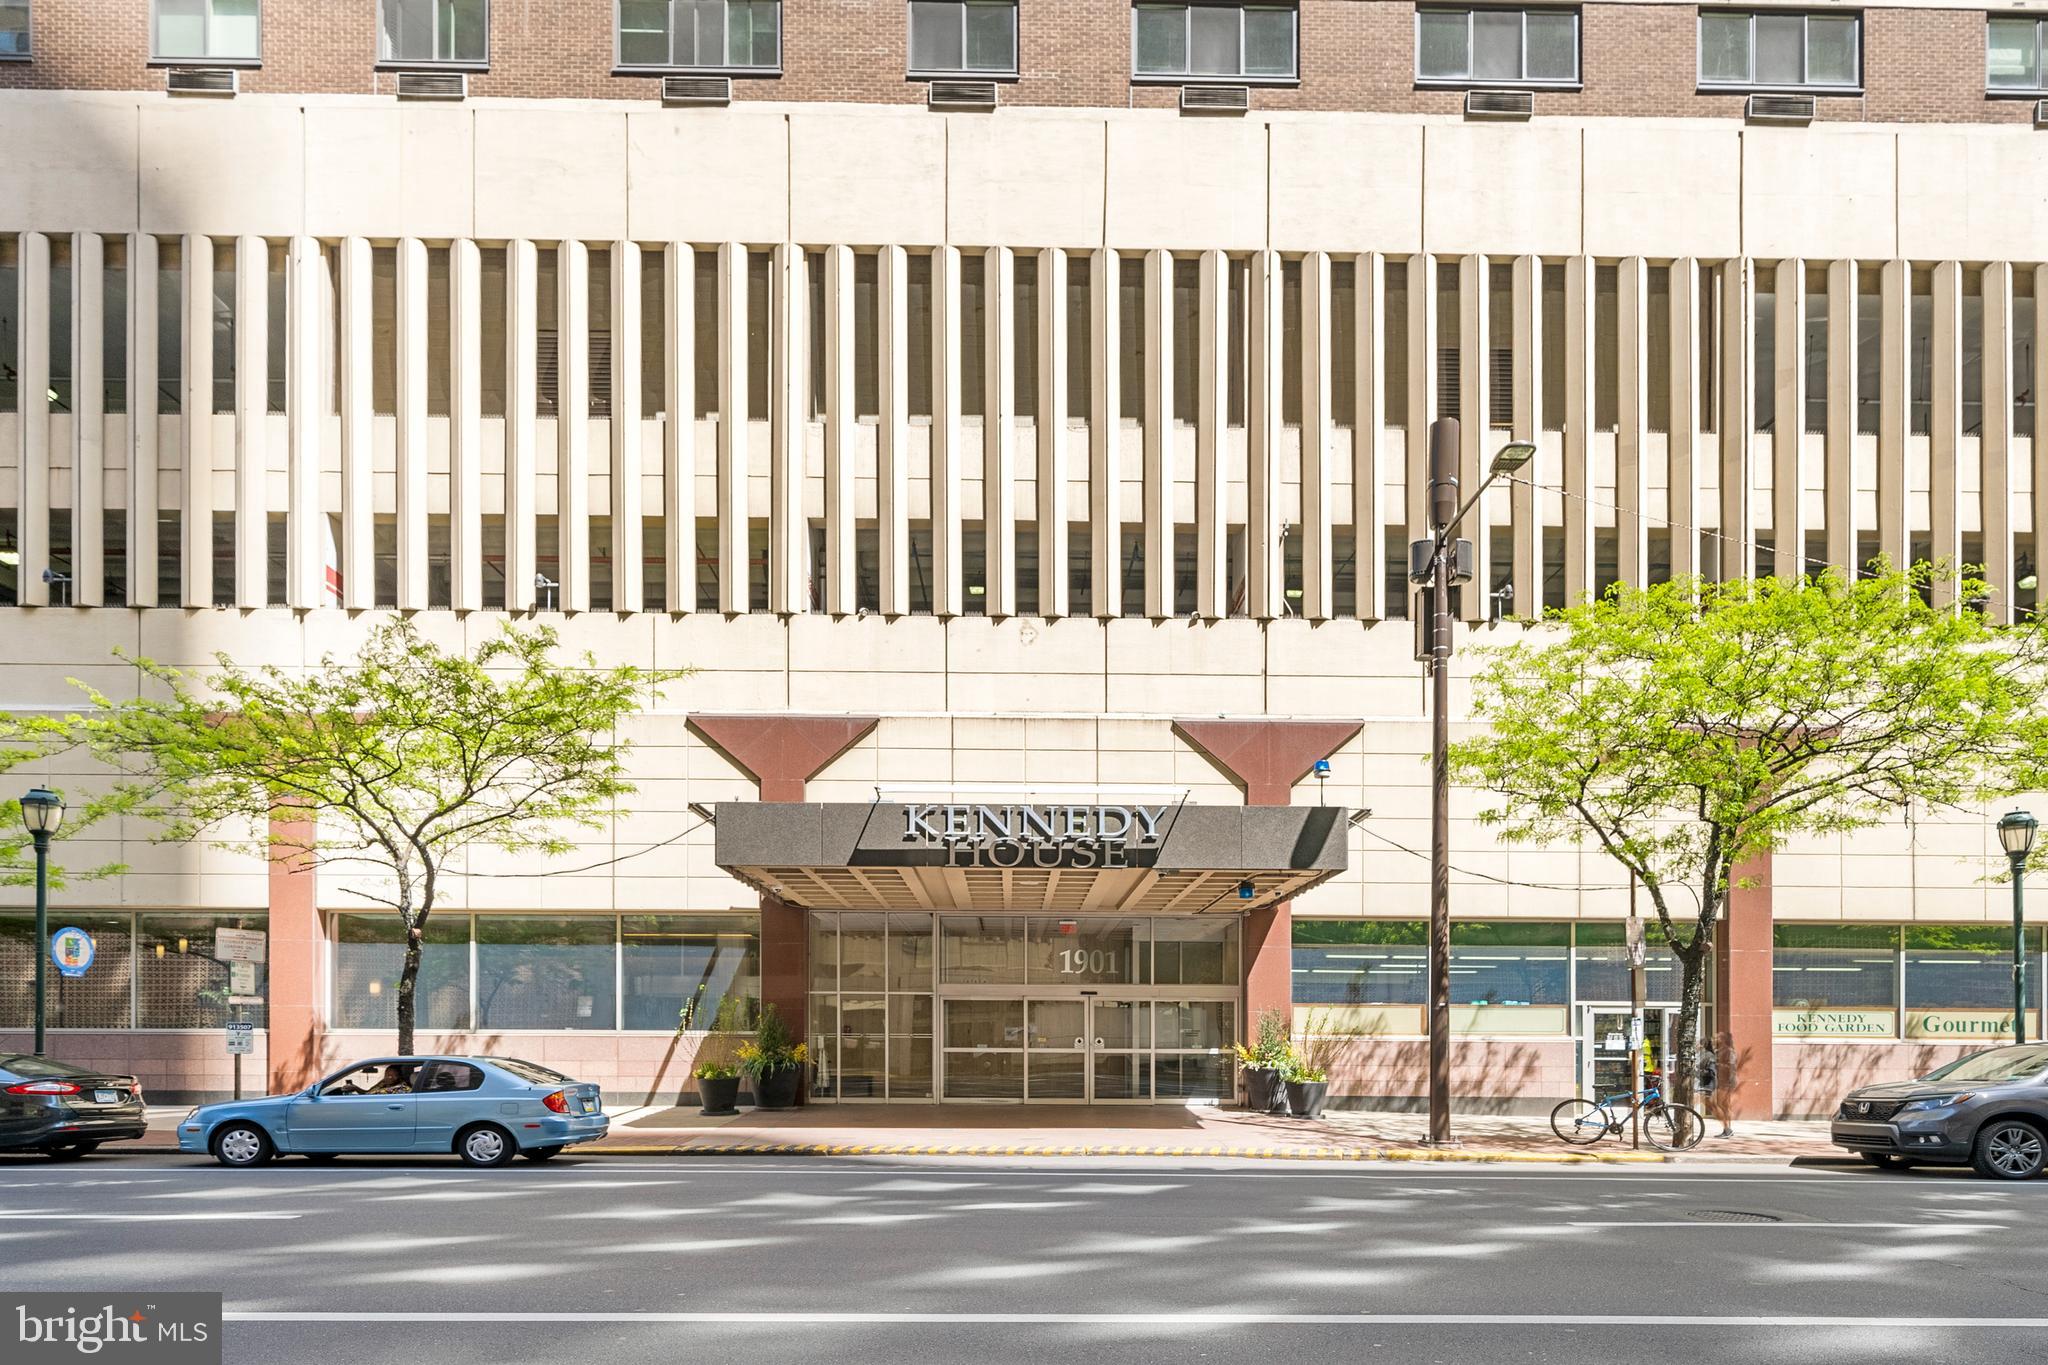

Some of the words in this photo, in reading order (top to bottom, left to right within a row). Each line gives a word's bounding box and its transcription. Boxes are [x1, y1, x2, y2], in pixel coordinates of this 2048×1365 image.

[904, 804, 1167, 837] KENNEDY
[945, 836, 1129, 868] HOUSE
[1059, 949, 1119, 974] 1901
[1778, 1023, 1818, 1032] FOOD
[1824, 1023, 1885, 1032] GARDEN
[1797, 1014, 1866, 1023] KENNEDY
